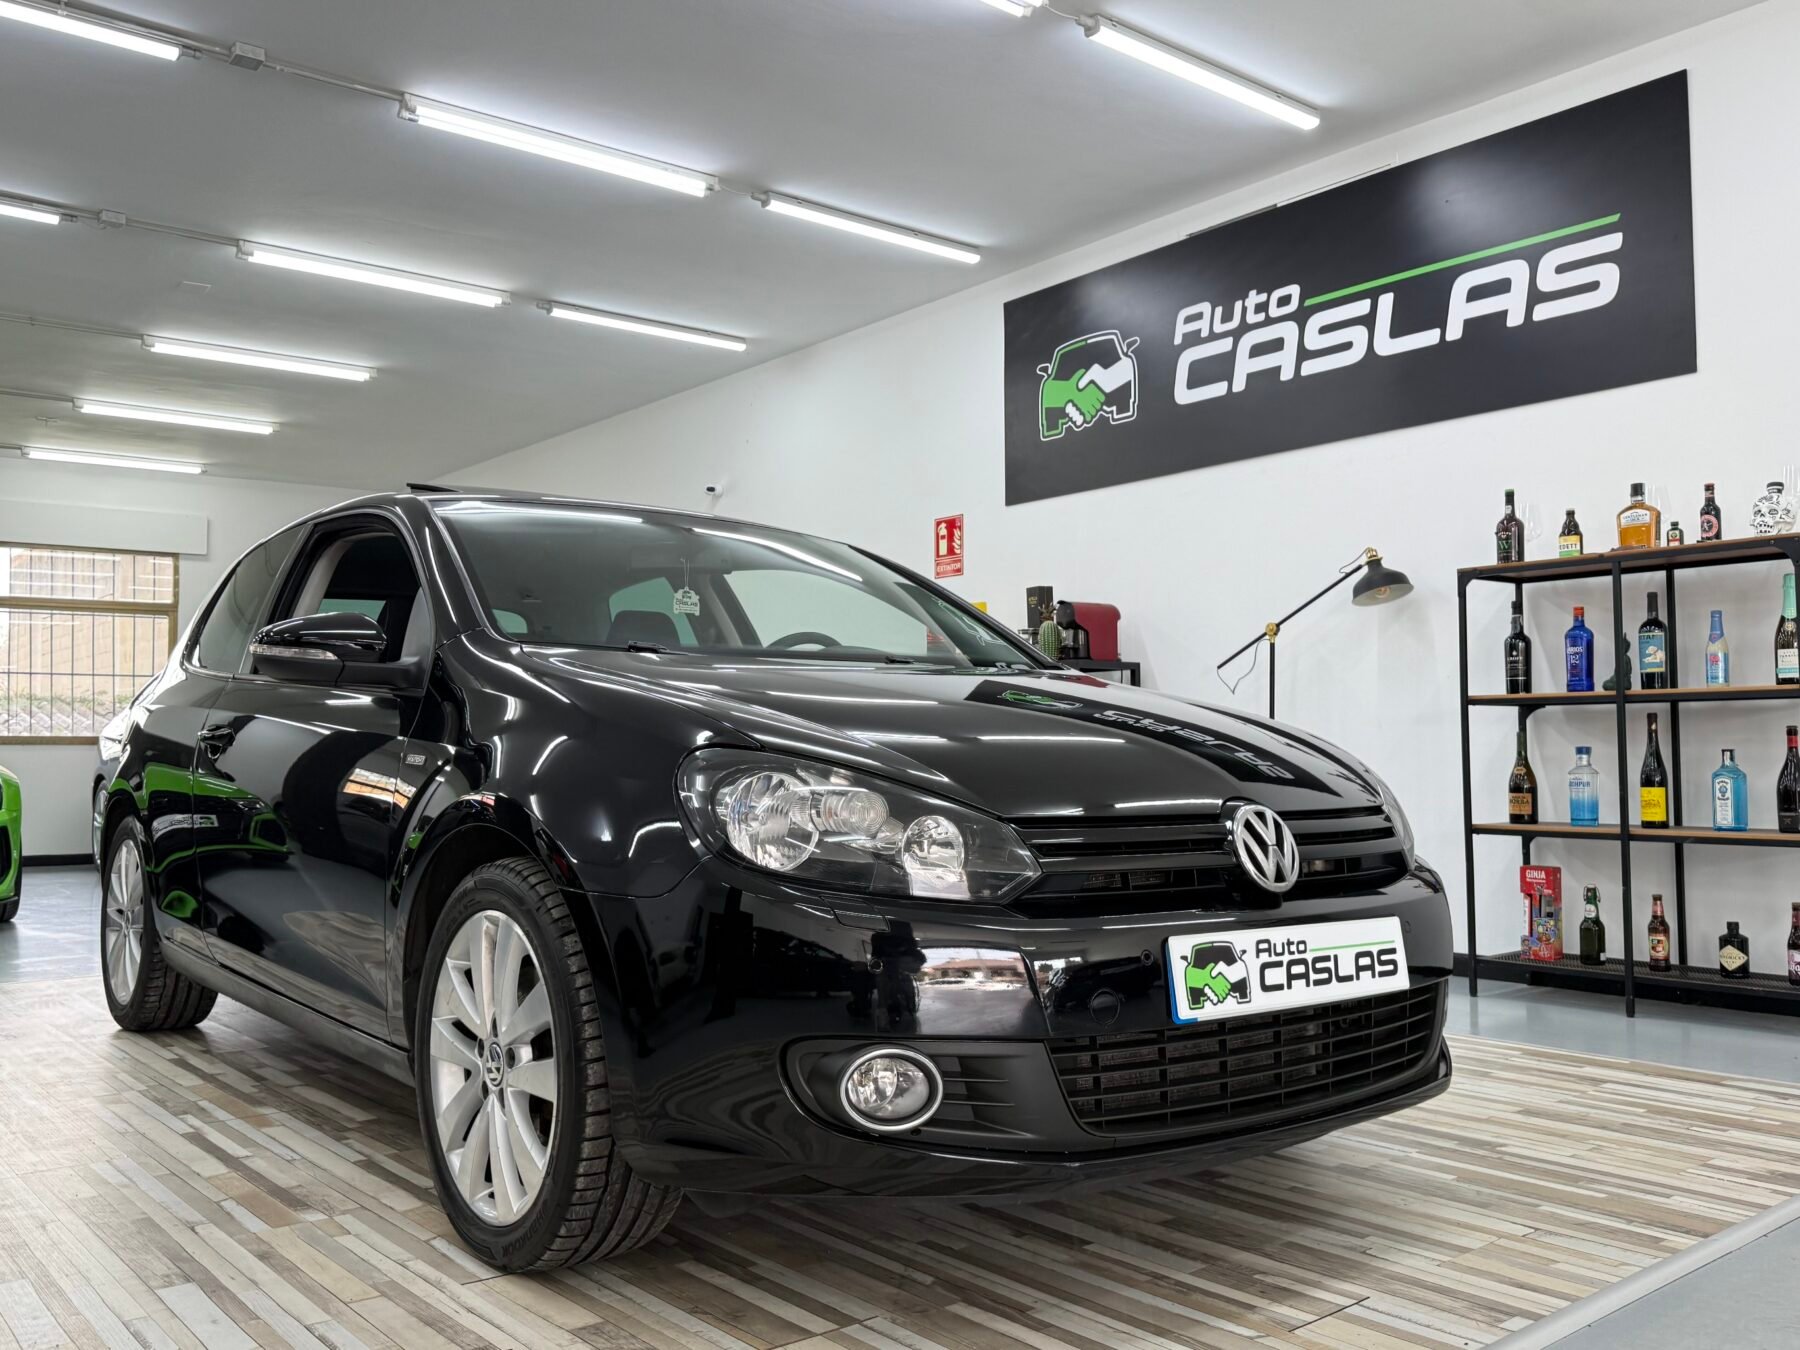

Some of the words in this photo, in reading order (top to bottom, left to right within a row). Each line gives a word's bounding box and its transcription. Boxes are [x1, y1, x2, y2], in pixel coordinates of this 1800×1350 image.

[1174, 284, 1300, 345] Auto
[1174, 232, 1624, 404] CASLAS
[937, 562, 961, 573] EXTINTOR
[1255, 938, 1308, 959] Auto
[1259, 947, 1398, 993] CASLAS
